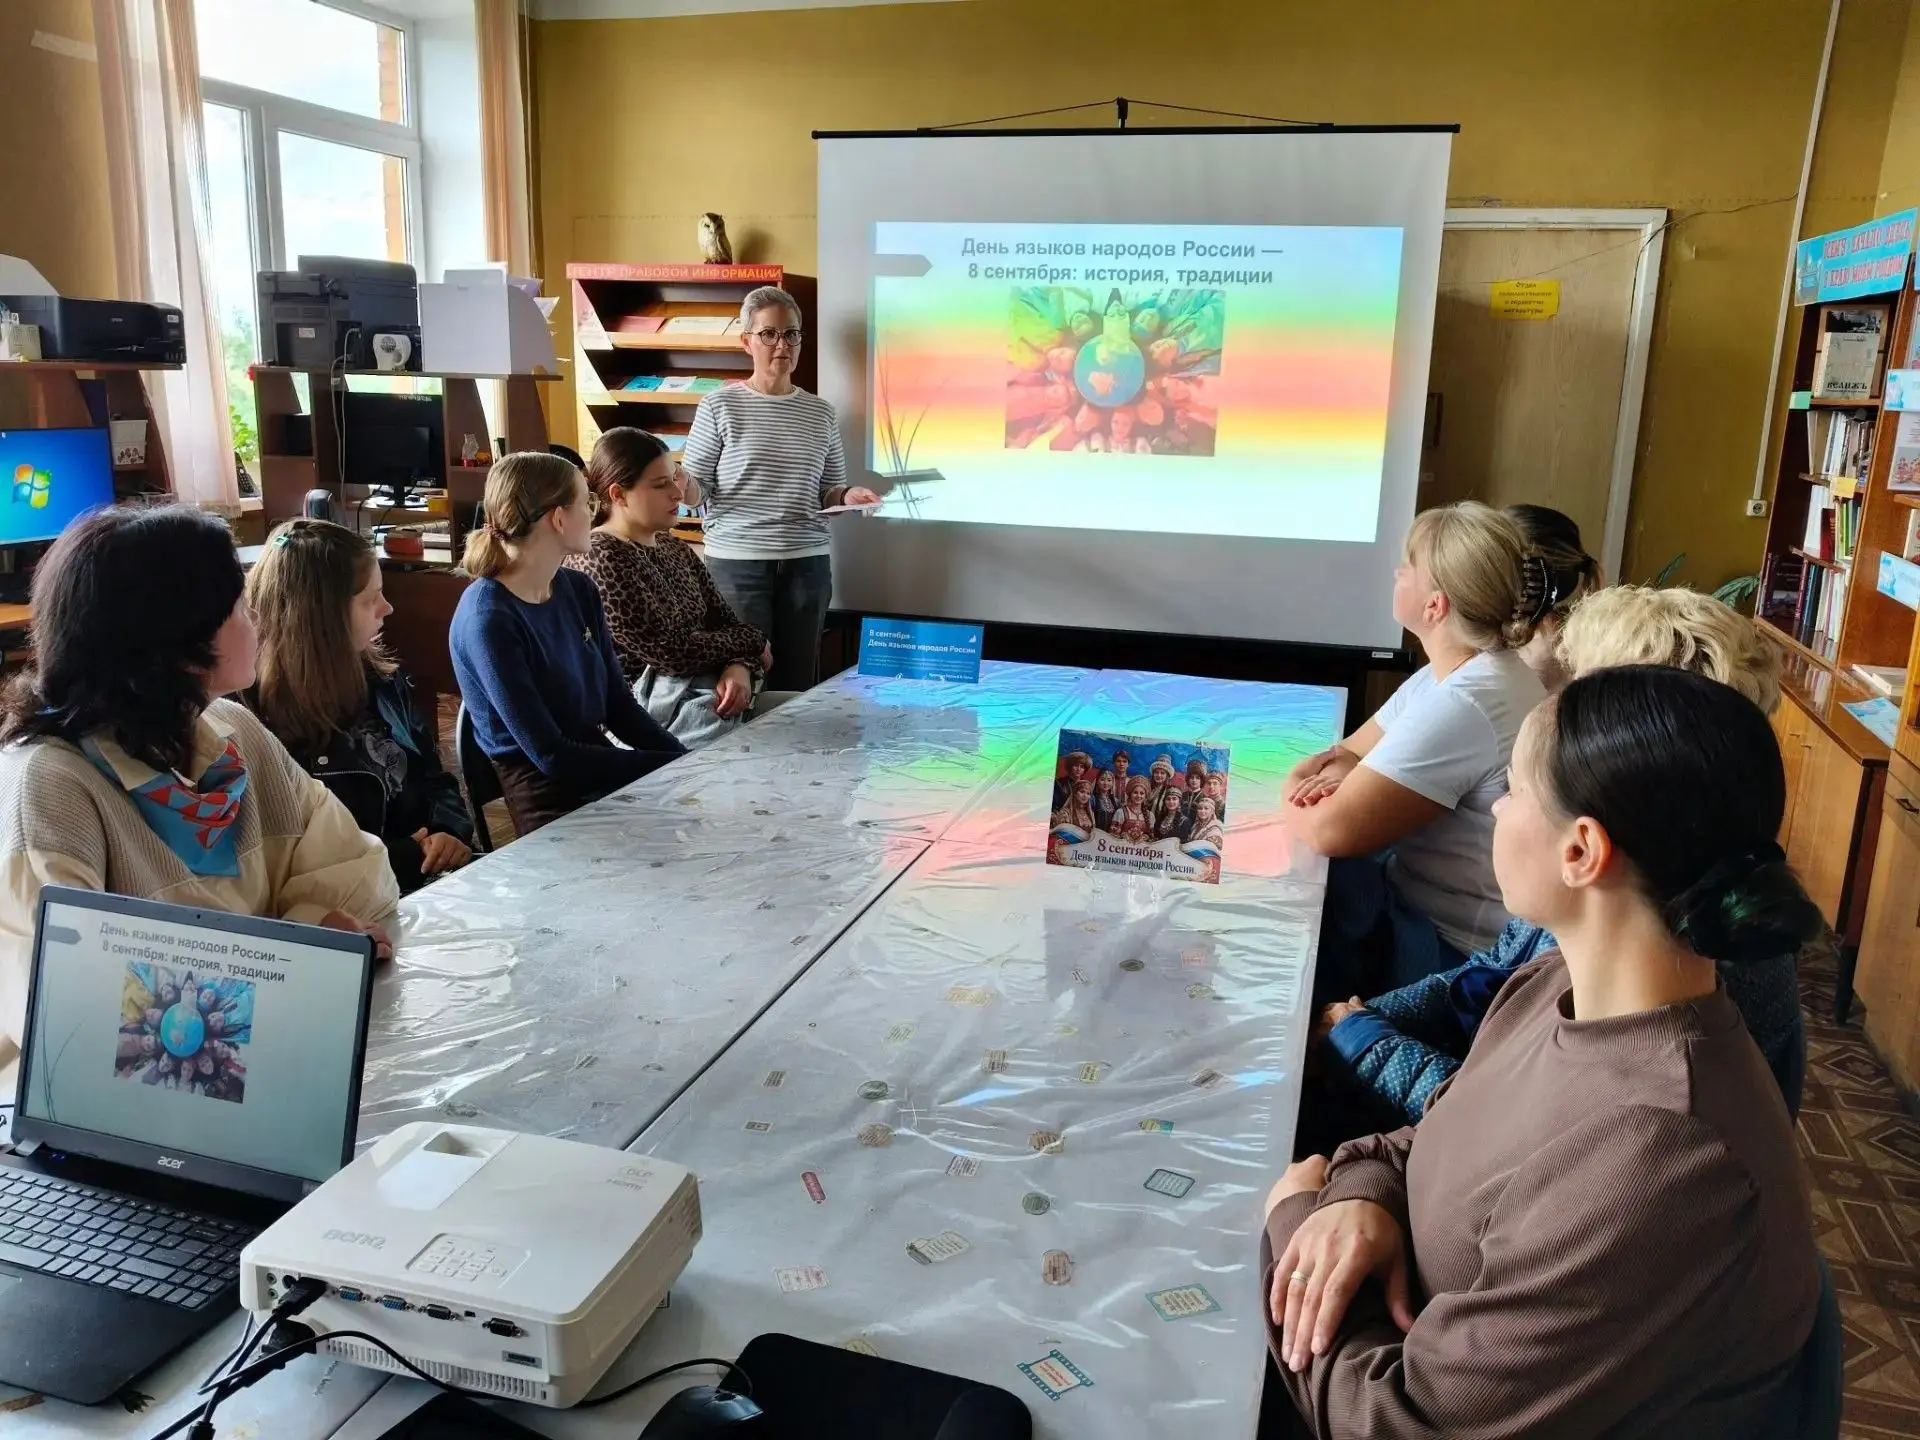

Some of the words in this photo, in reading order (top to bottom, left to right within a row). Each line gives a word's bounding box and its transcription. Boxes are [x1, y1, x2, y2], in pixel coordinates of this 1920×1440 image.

[961, 238, 1009, 256] День
[1015, 242, 1086, 255] языков
[1092, 243, 1176, 260] народов
[1183, 240, 1255, 257] России
[621, 267, 688, 279] ПРАВОВОЙ
[692, 268, 782, 280] ИНФОРМАЦИИ
[968, 262, 978, 279] 8
[984, 263, 1077, 284] сентября:
[1084, 267, 1169, 285] история,
[1177, 269, 1273, 286] традиции
[868, 638, 887, 647] День
[888, 642, 916, 650] языков
[917, 645, 948, 653] народов
[949, 645, 976, 654] России
[875, 631, 910, 640] сентября
[1097, 838, 1107, 852] 8
[1109, 845, 1164, 860] сентября
[1071, 850, 1093, 861] День
[1094, 855, 1127, 866] языков
[1128, 860, 1163, 871] народов
[100, 922, 128, 937] День
[132, 930, 175, 945] языков
[177, 936, 228, 954] народов
[232, 944, 276, 962] России
[102, 940, 109, 952] 8
[112, 944, 169, 962] сентября:
[172, 954, 223, 973] история,
[227, 963, 285, 982] традиции
[157, 1156, 186, 1169] acer
